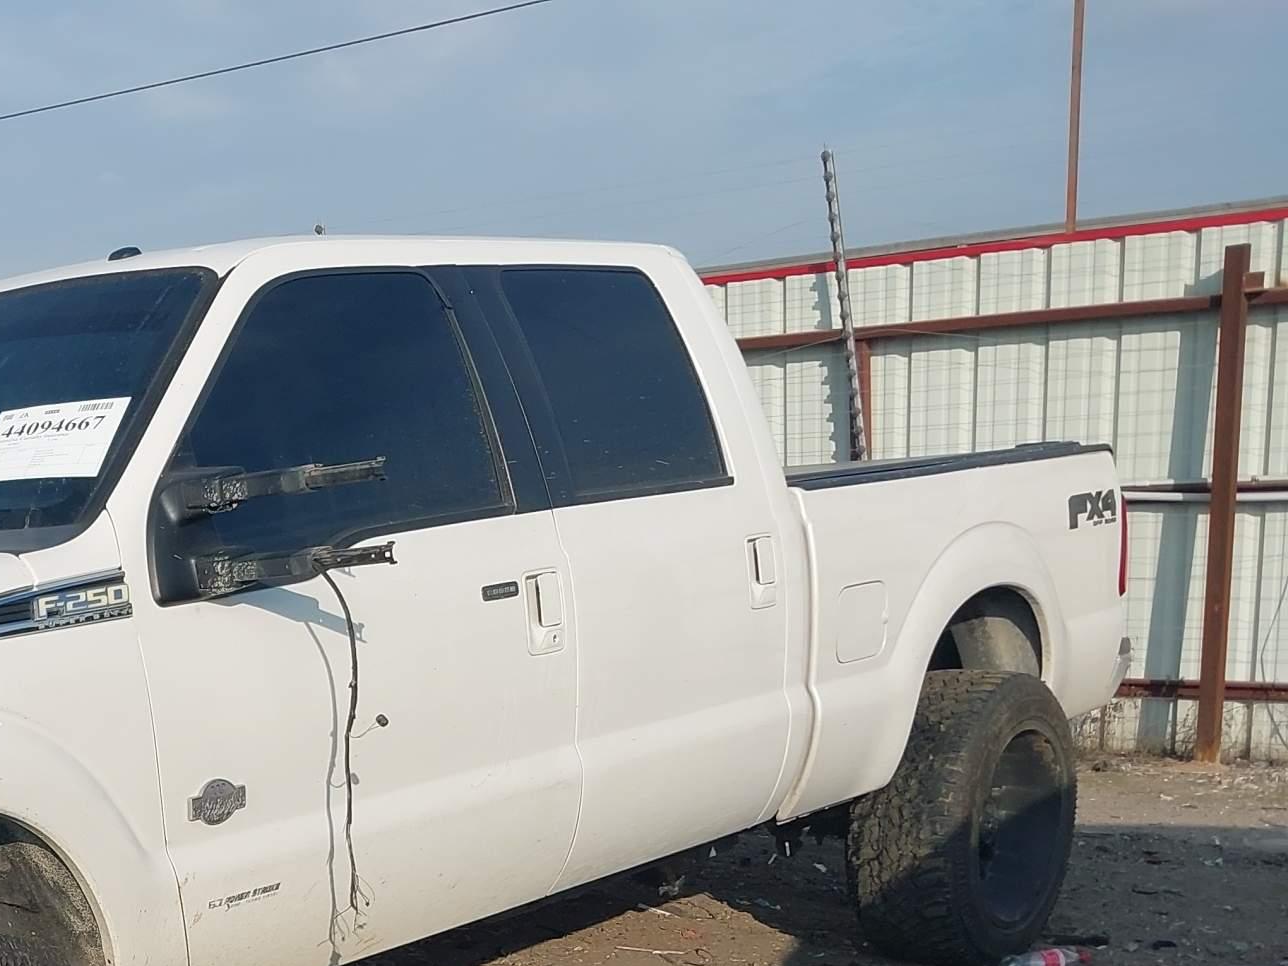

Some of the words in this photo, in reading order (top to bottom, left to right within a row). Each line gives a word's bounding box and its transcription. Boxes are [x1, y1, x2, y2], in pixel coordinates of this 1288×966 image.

[1, 415, 107, 438] 44094667
[1068, 488, 1117, 529] FX4
[37, 584, 130, 619] F-250
